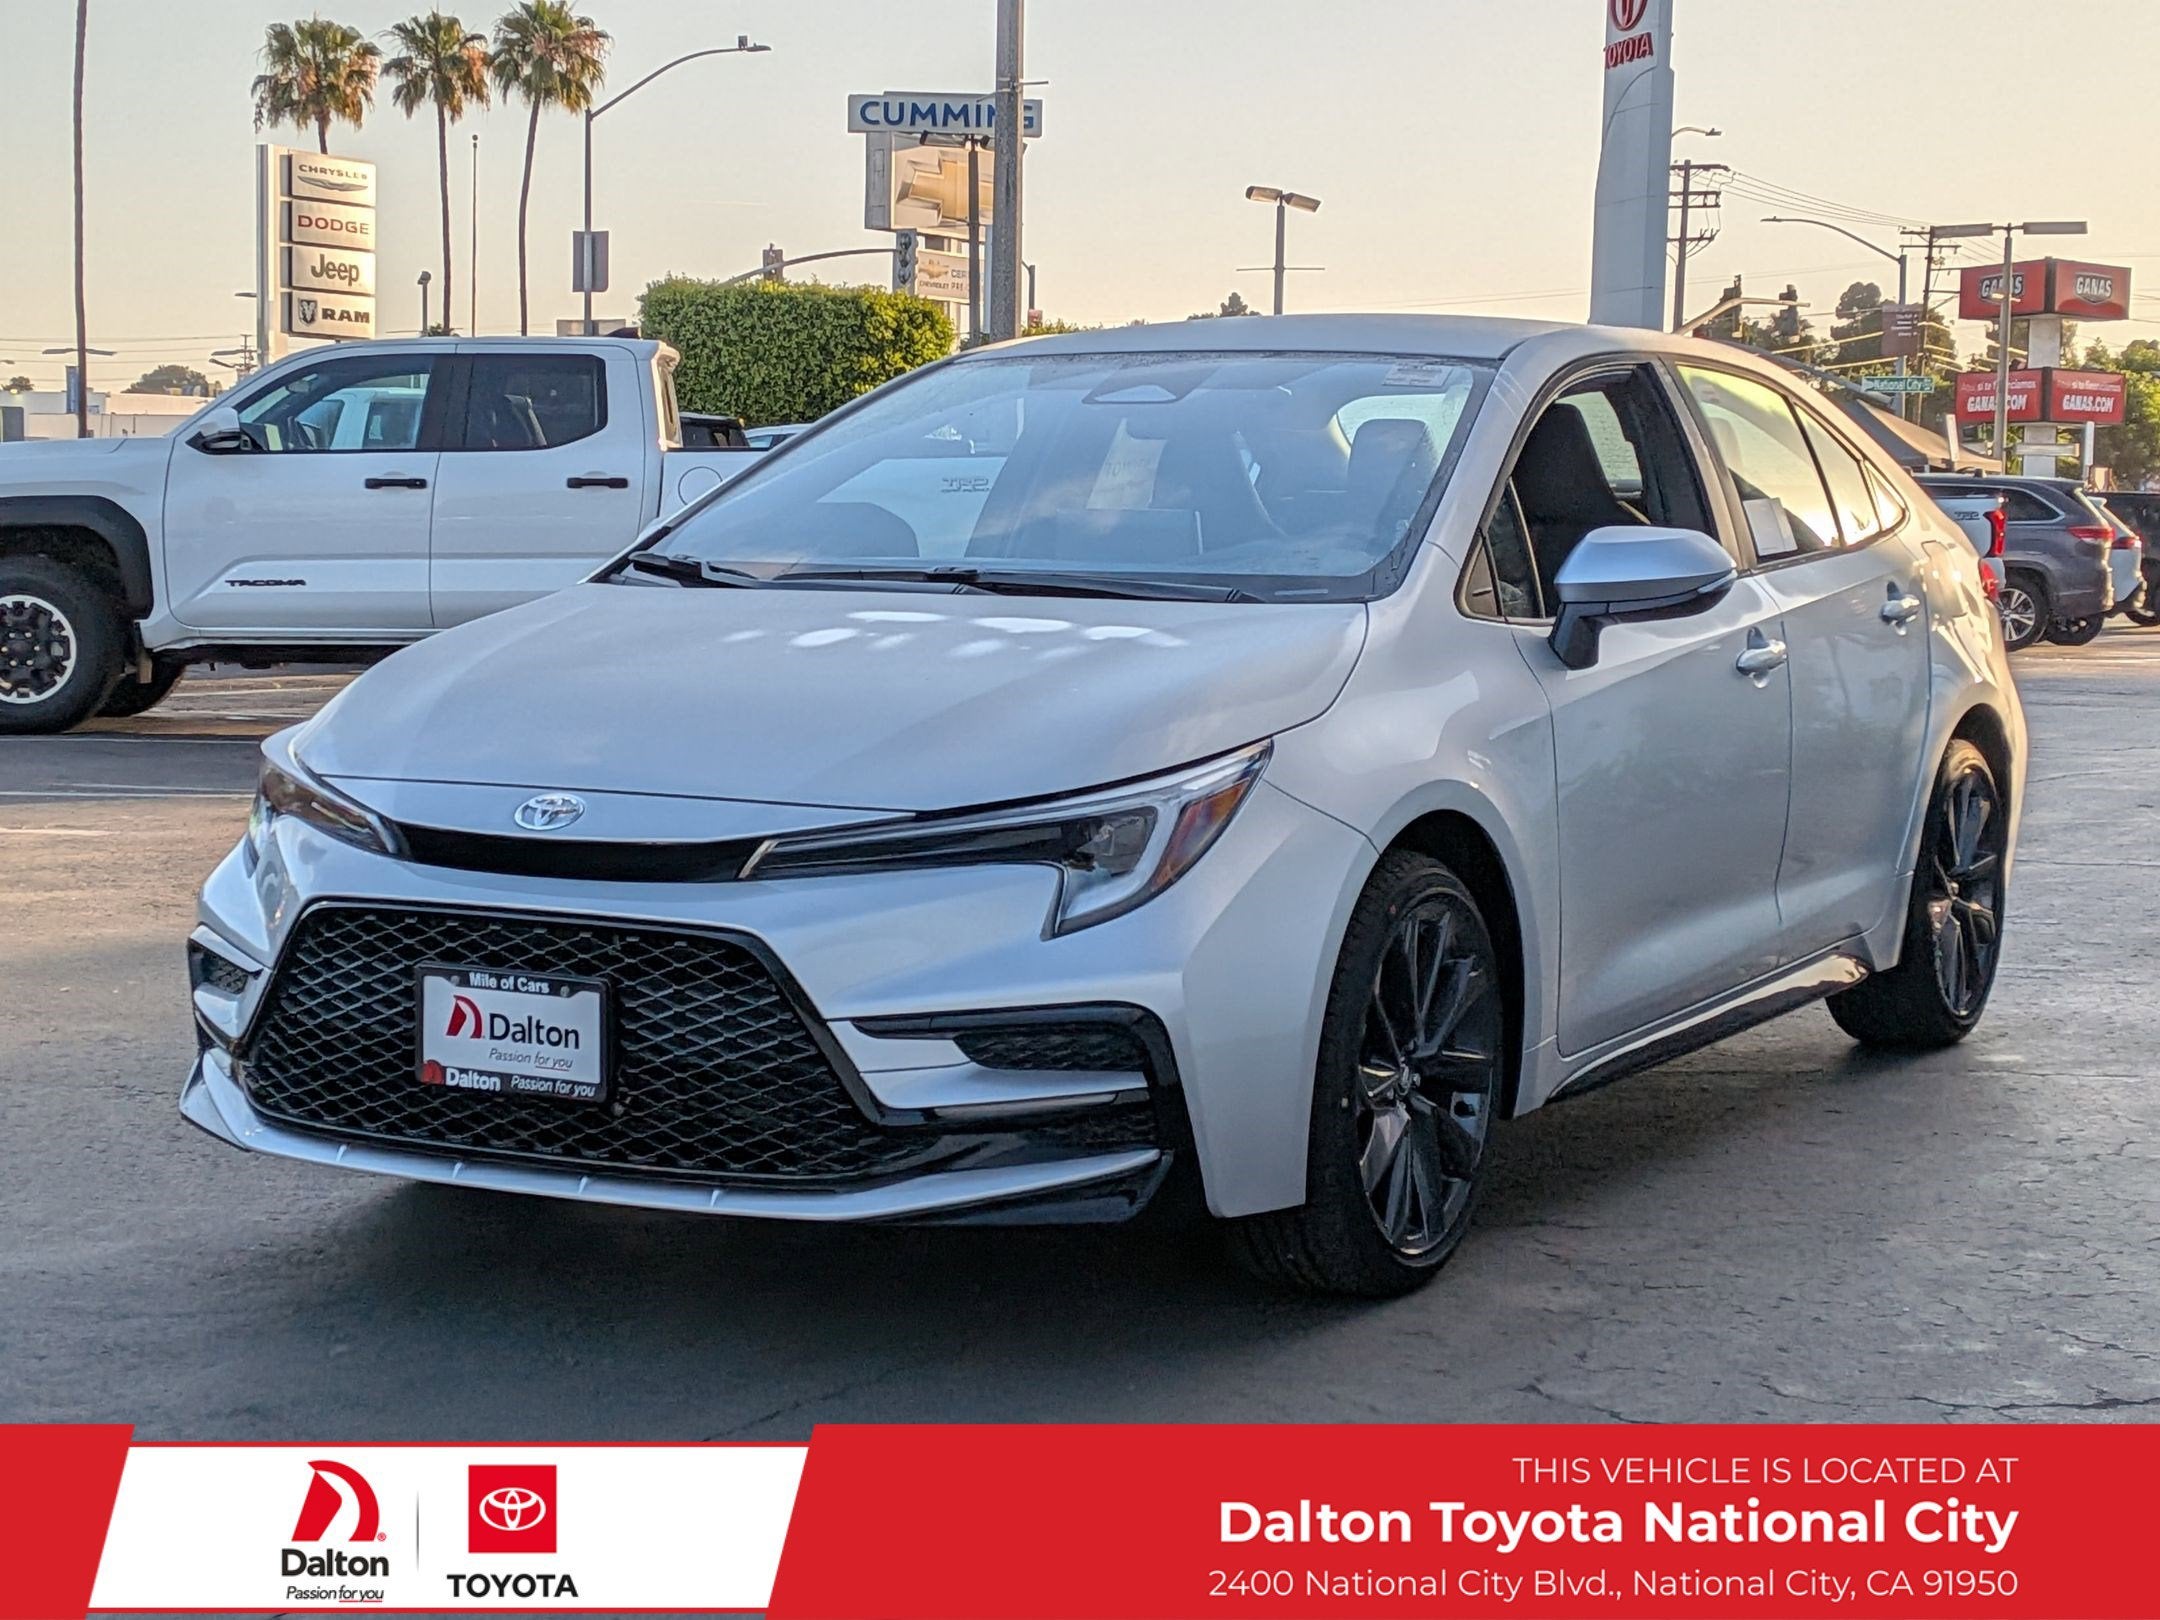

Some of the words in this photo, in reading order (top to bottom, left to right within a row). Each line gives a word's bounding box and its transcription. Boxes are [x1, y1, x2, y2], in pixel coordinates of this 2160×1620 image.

[297, 214, 370, 235] DODGE
[310, 253, 359, 286] Jeep
[2076, 276, 2112, 297] GANAS
[321, 307, 370, 323] RAM
[2063, 395, 2114, 412] GANAS.COM
[225, 579, 307, 587] TACOMA
[469, 972, 497, 988] Mile
[500, 975, 515, 990] of
[517, 978, 550, 994] Cars
[489, 1013, 580, 1050] Dalton
[489, 1047, 531, 1062] Passion
[534, 1051, 550, 1066] for
[551, 1057, 573, 1069] you
[446, 1067, 501, 1091] Dalton
[511, 1075, 553, 1092] Passion
[553, 1080, 570, 1096] for
[573, 1083, 596, 1098] you
